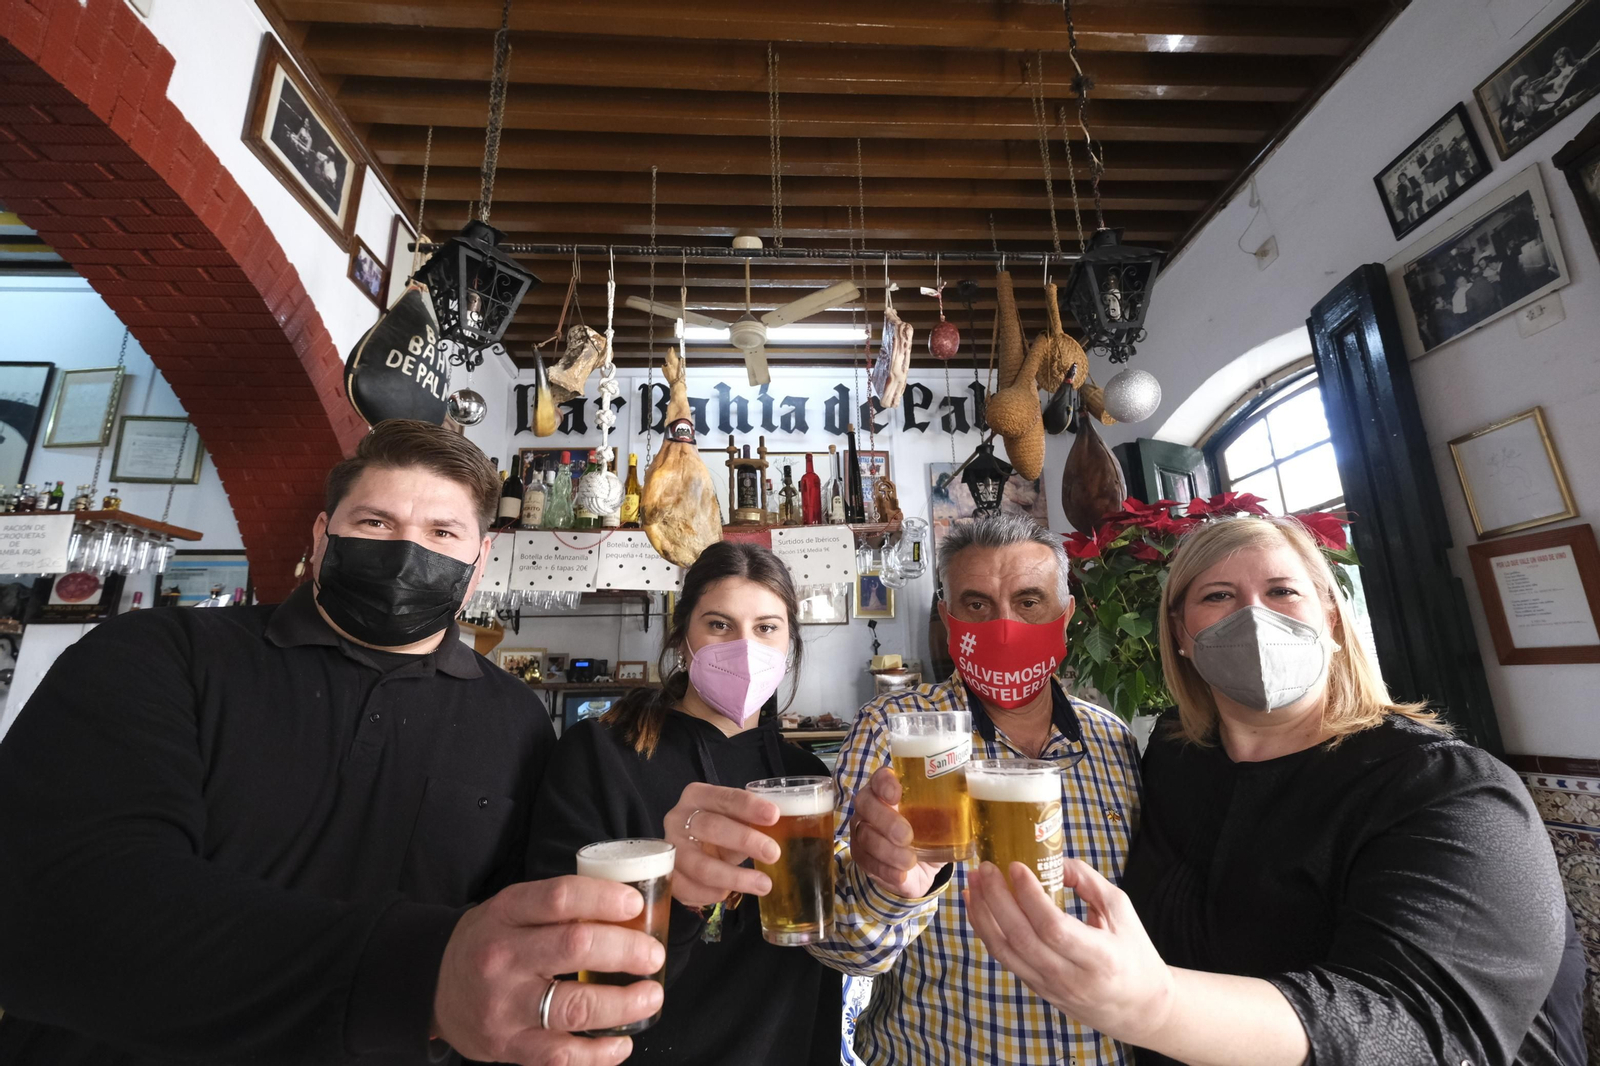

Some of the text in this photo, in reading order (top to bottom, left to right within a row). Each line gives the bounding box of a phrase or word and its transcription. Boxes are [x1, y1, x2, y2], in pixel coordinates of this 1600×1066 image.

[824, 383, 889, 436] de
[557, 564, 574, 572] tapas
[958, 656, 1057, 686] SALVEMOSLA
